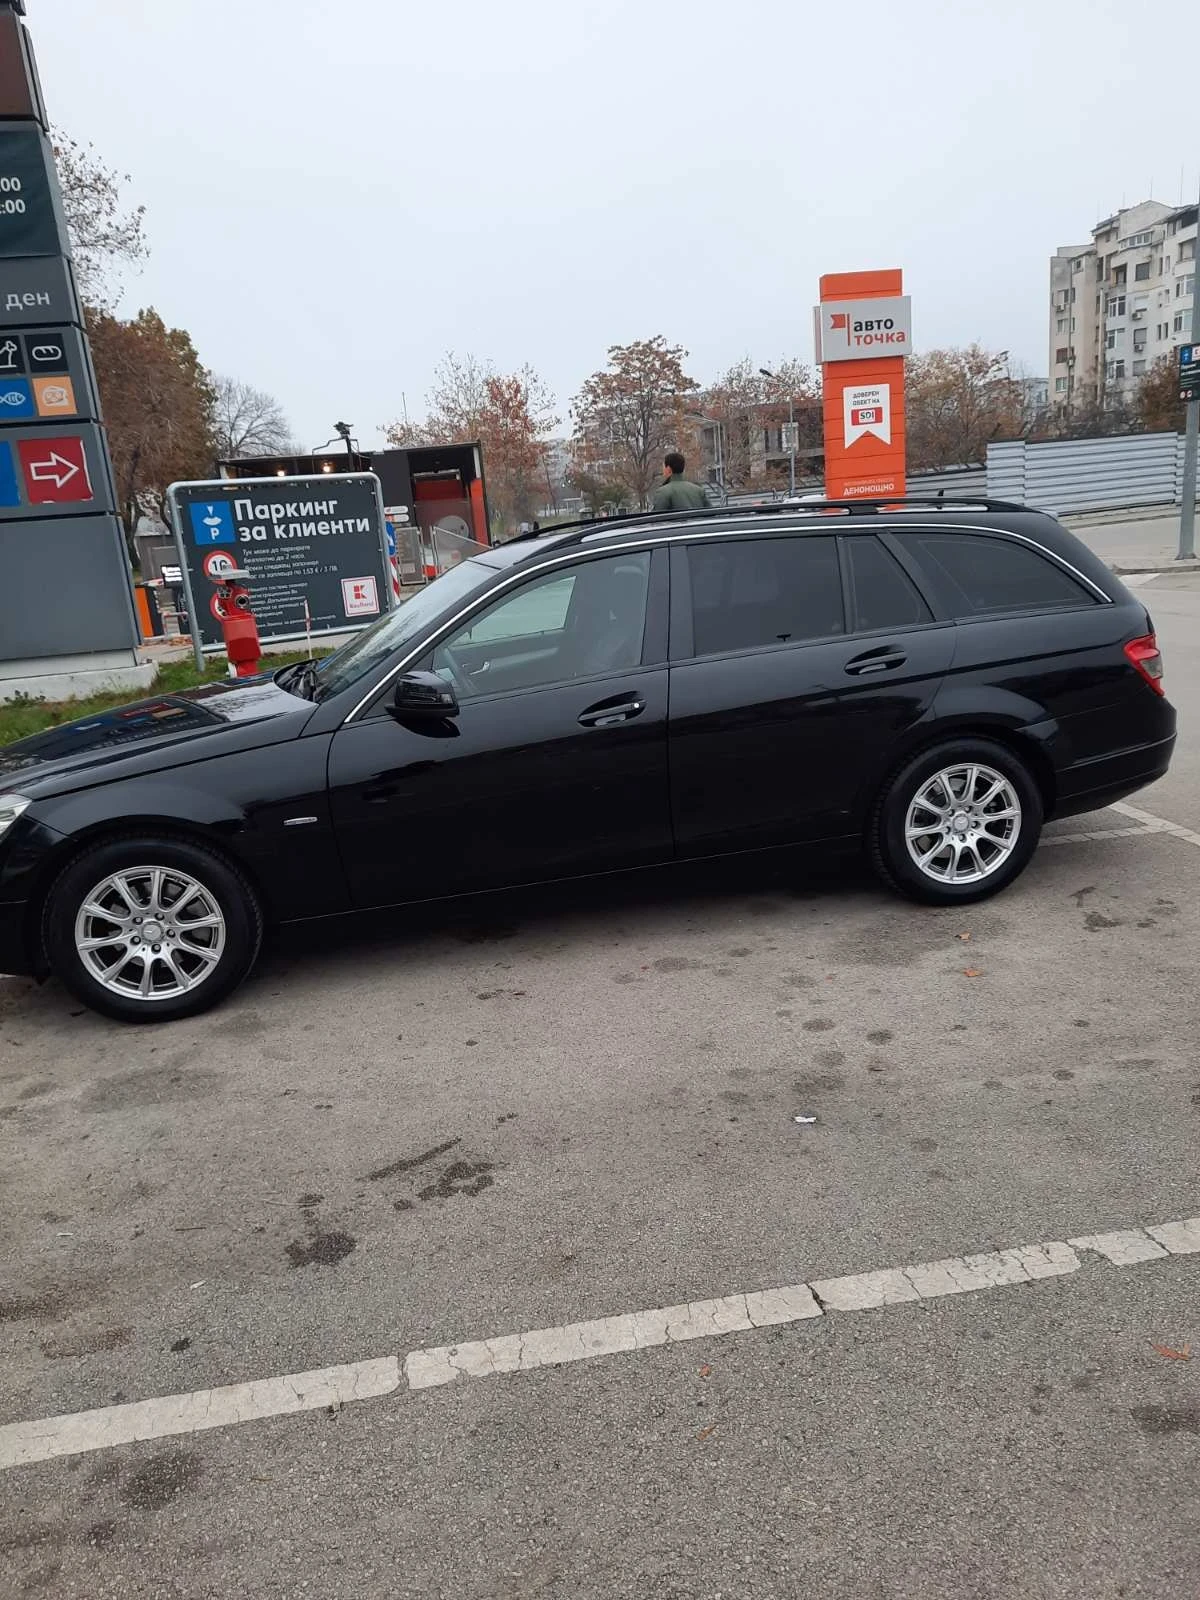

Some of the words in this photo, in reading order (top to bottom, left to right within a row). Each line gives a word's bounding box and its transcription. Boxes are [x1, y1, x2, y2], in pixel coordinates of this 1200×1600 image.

[0, 177, 21, 192] 00
[0, 199, 26, 214] :00
[6, 292, 50, 311] ден
[854, 318, 894, 332] авто
[854, 331, 906, 346] точка
[843, 483, 895, 496] ДЕНОНОЩНО
[234, 499, 338, 524] Паркинг
[238, 525, 267, 542] за
[274, 518, 370, 539] клиенти
